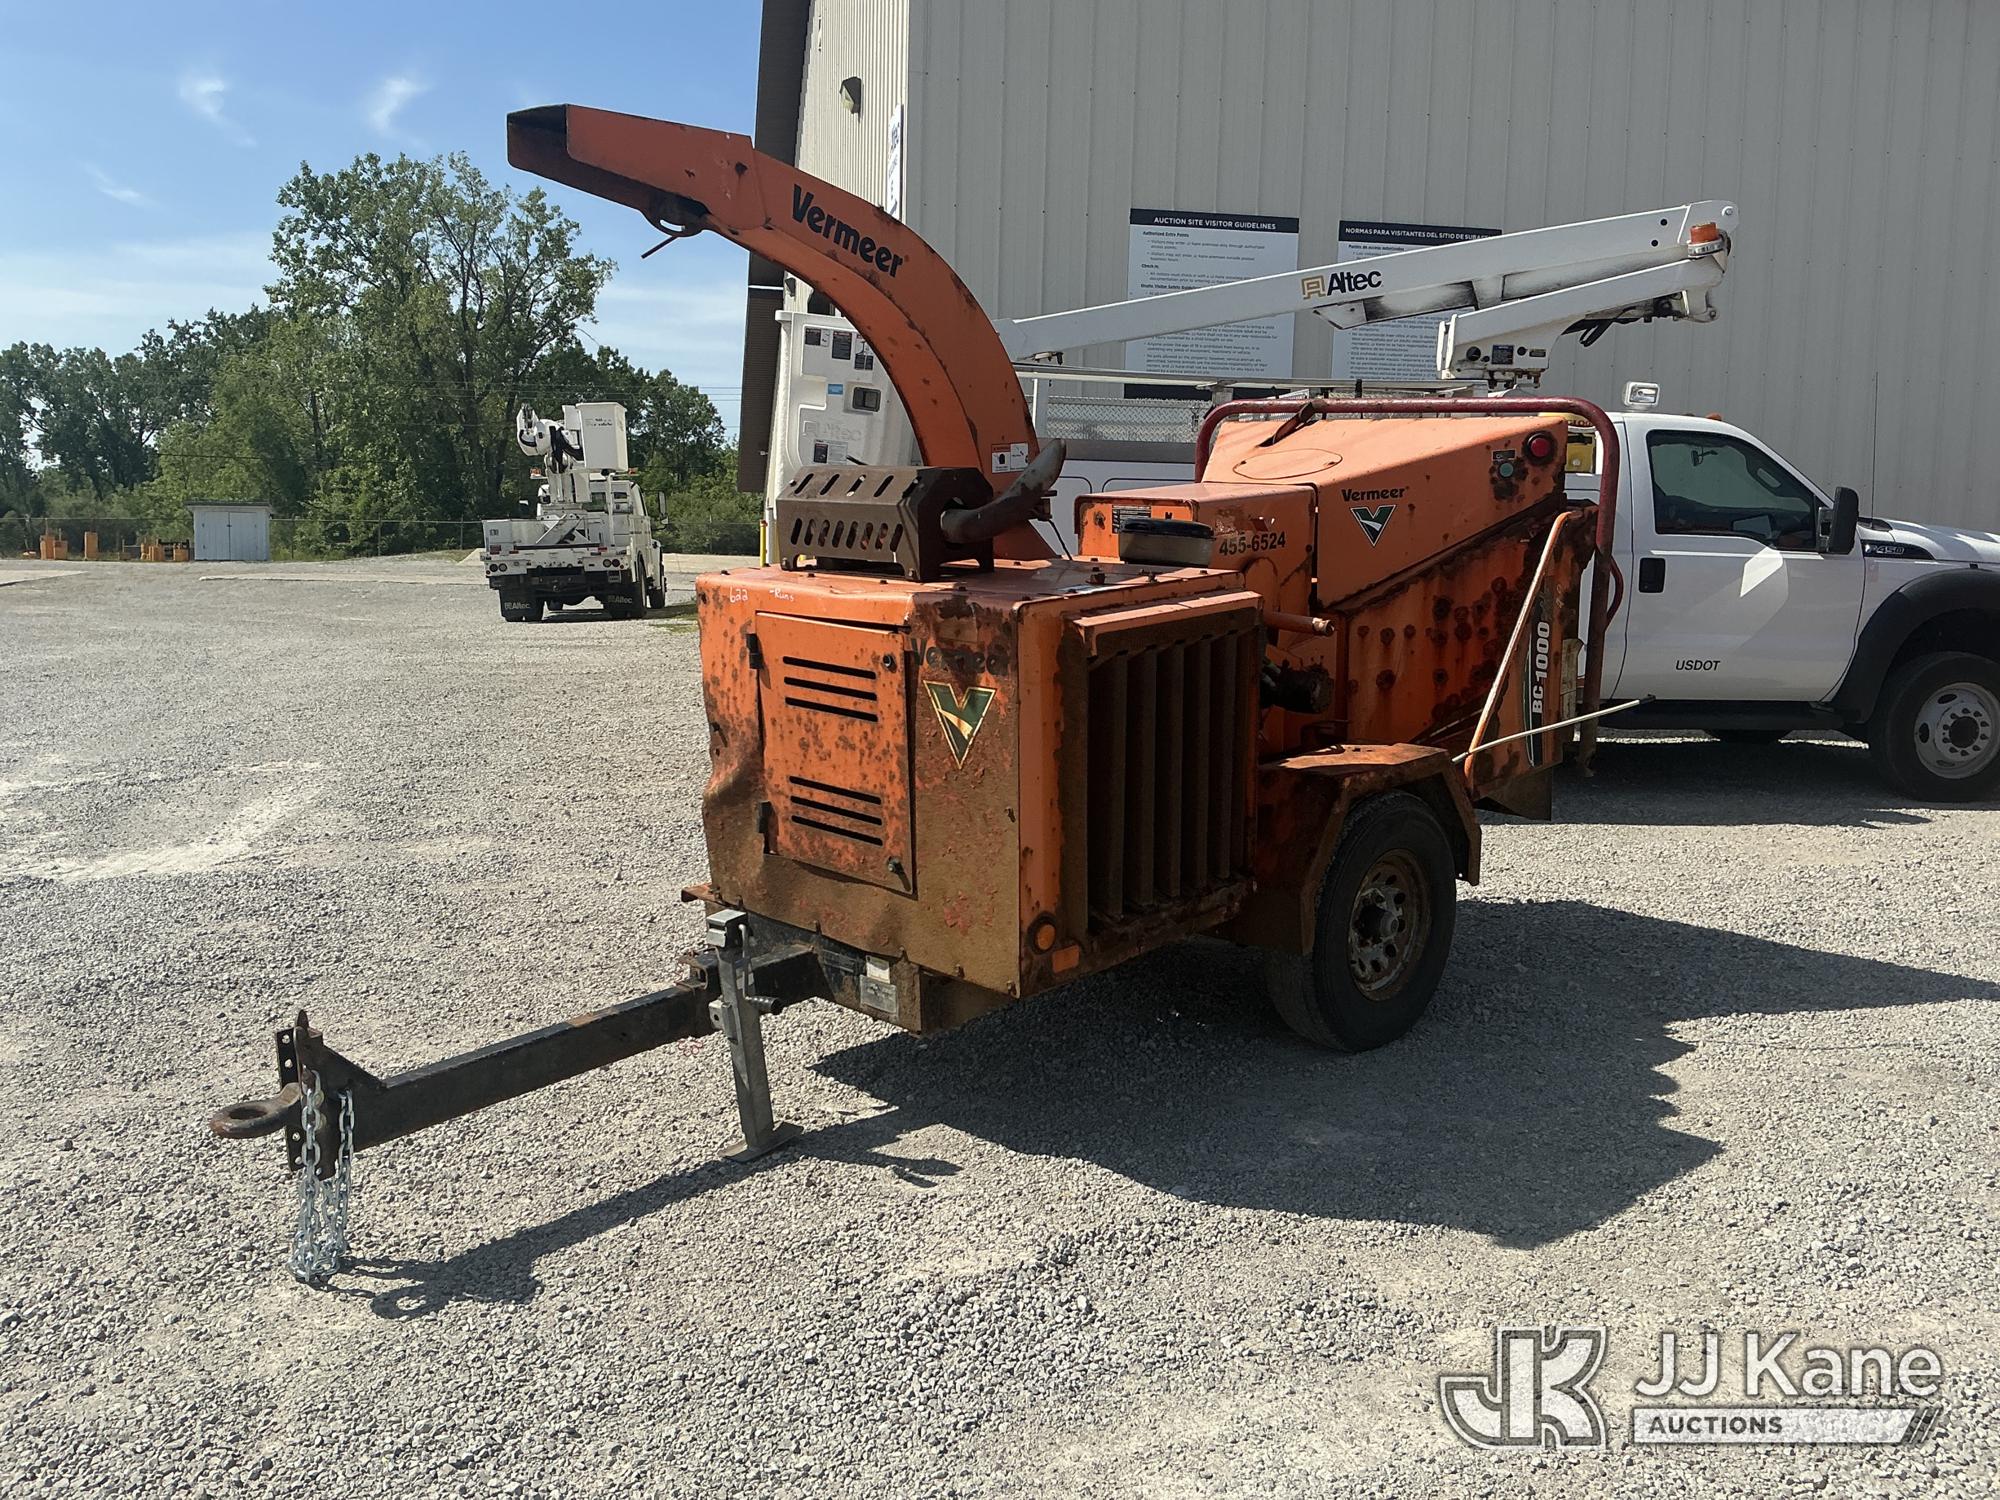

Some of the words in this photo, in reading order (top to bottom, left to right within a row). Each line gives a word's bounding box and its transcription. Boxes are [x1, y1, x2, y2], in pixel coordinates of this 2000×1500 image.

[792, 184, 903, 278] Vermeer
[1154, 217, 1186, 225] AUCTION
[1205, 220, 1233, 228] VISITOR
[1235, 222, 1276, 230] GUIDELINES
[1391, 230, 1425, 238] VISITANTES
[1327, 271, 1382, 296] Altec
[1341, 488, 1405, 502] Vermeer
[1219, 531, 1286, 556] 455-6524
[1532, 621, 1550, 714] BC1000
[1675, 660, 1721, 671] USDOT
